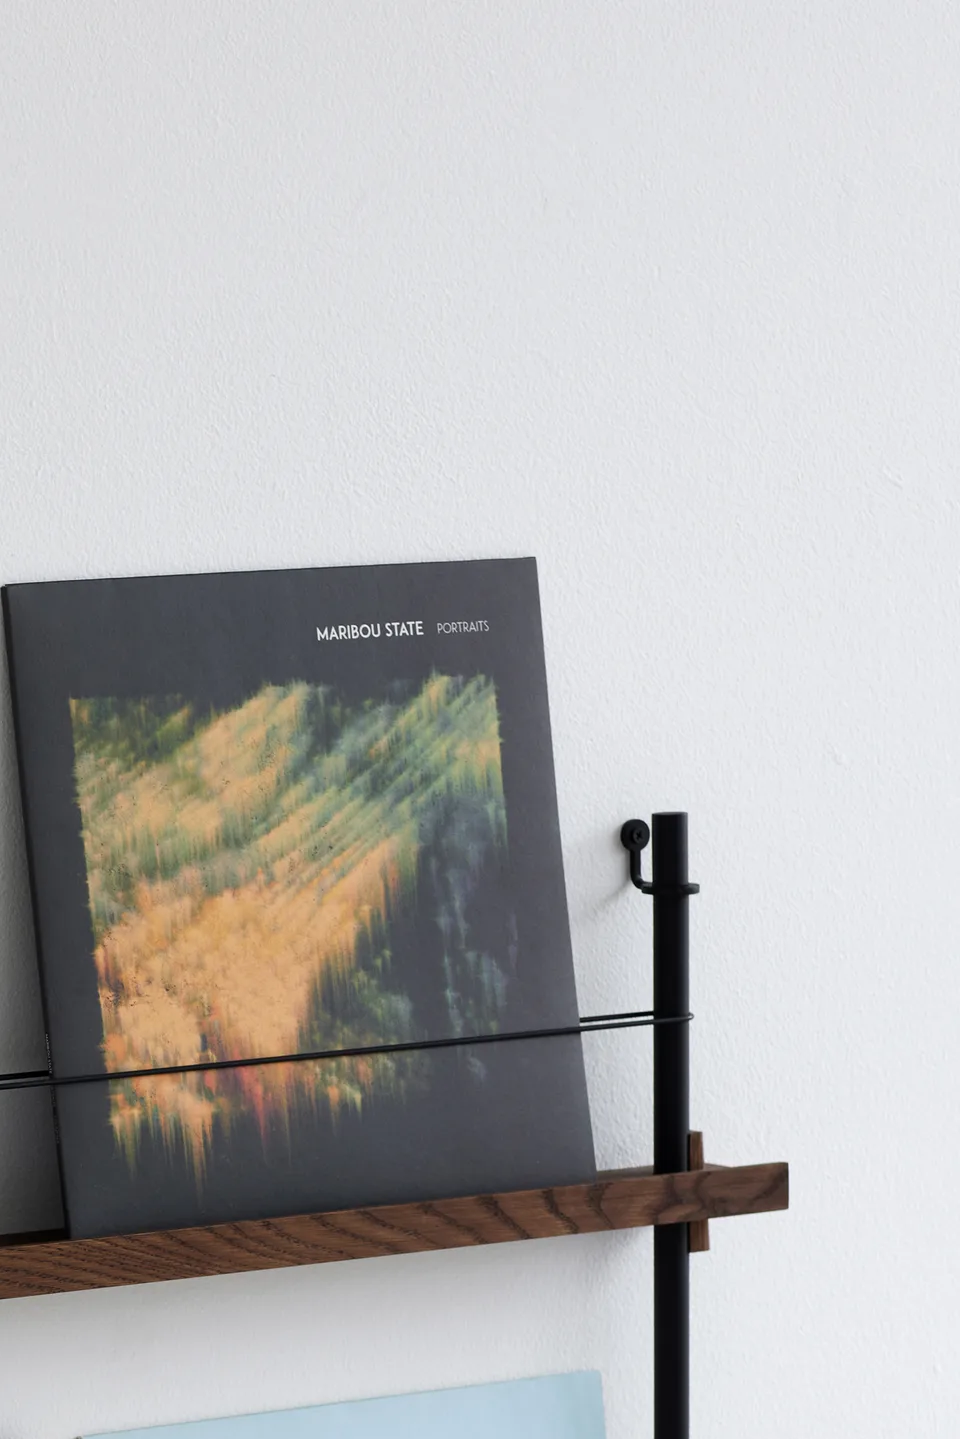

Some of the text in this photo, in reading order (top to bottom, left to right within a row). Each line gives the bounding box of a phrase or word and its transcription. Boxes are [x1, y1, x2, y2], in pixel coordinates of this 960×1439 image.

[316, 620, 490, 641] MARIBOU STATE PORTRAITS
